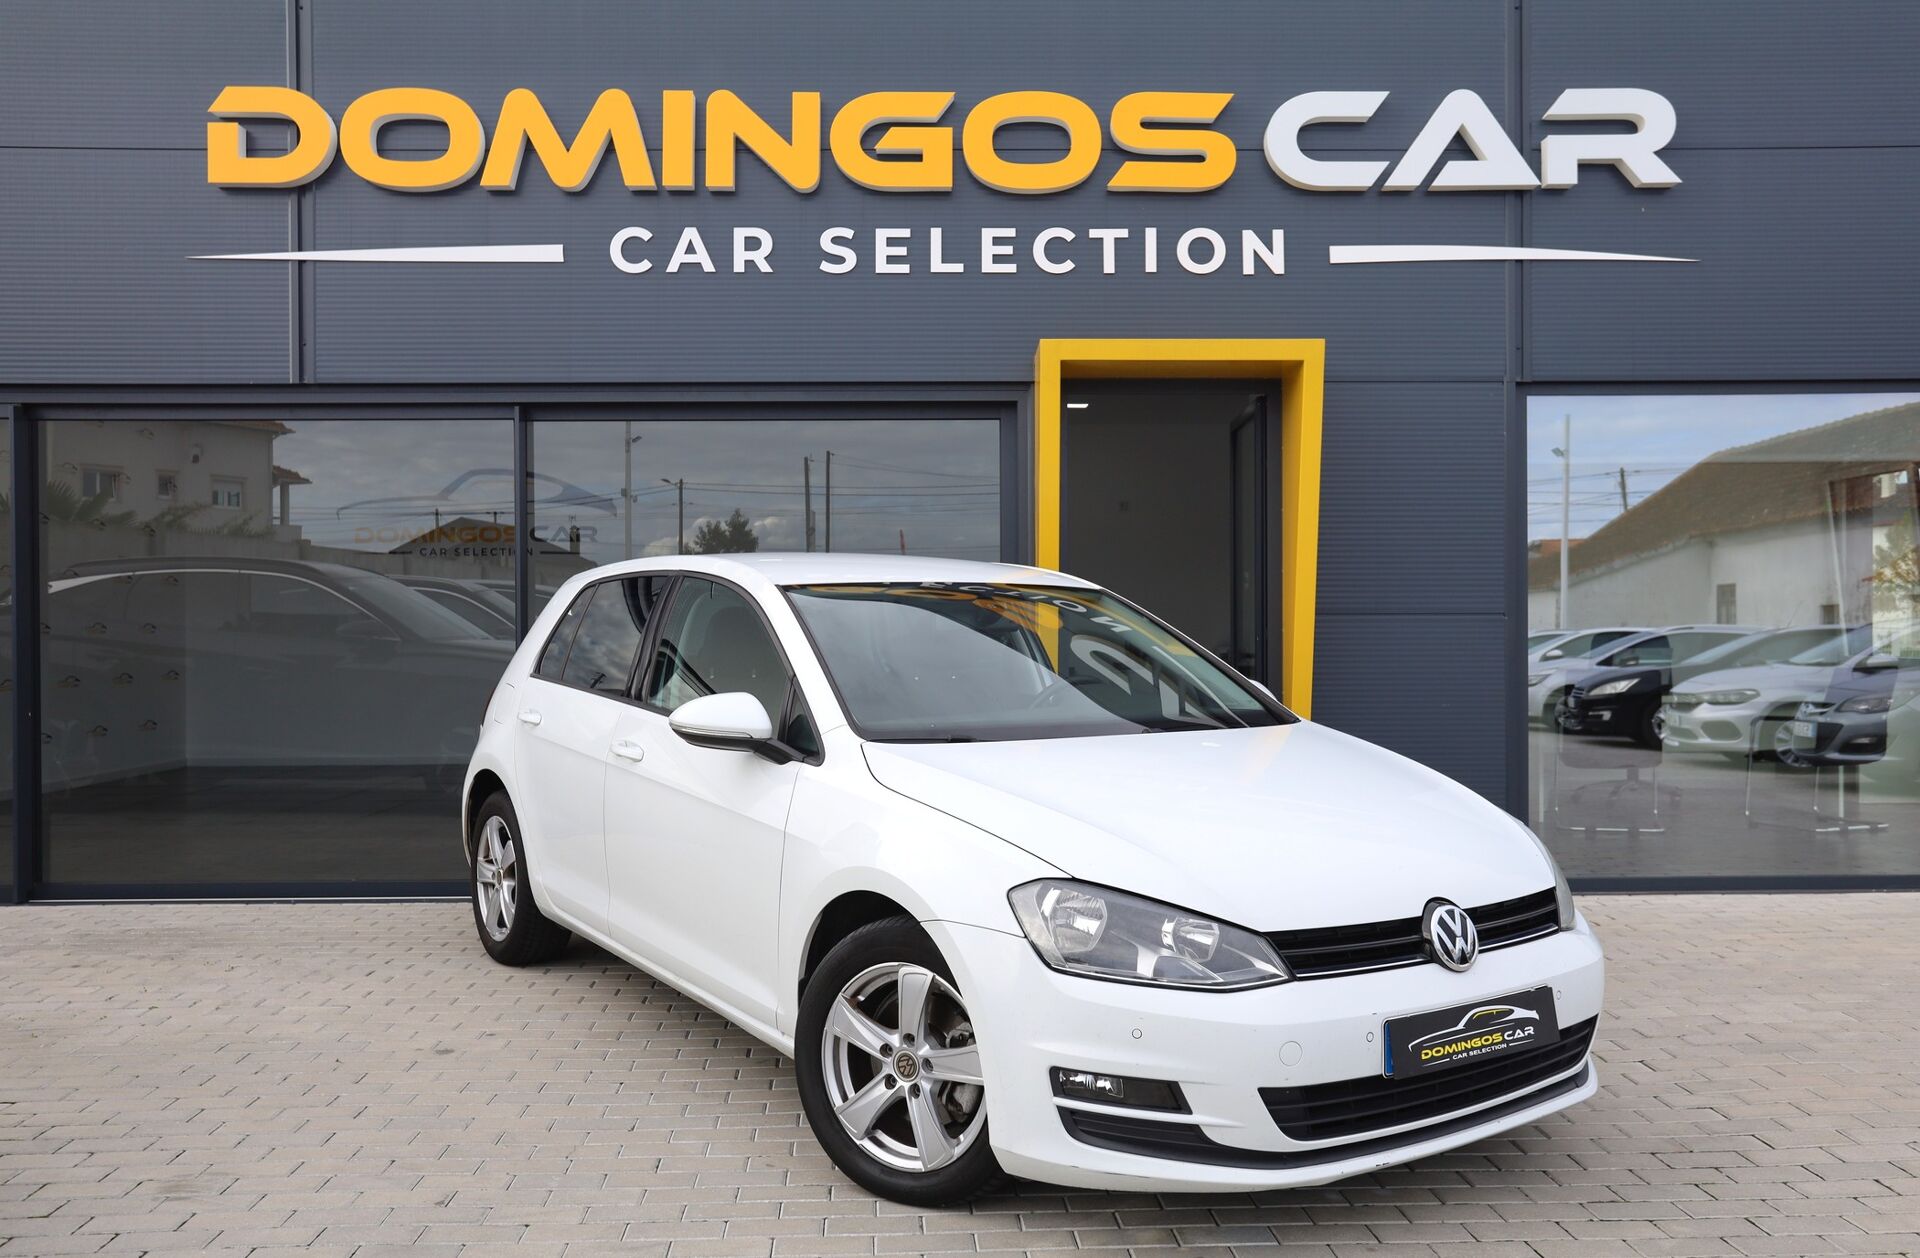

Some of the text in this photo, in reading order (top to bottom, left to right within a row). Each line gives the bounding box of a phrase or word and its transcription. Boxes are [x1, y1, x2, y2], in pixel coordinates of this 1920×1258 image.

[207, 86, 1683, 193] DOMINGOS CAR
[609, 226, 1286, 275] CAR SELECTION
[353, 526, 598, 544] DOMINGOS CAR
[419, 547, 534, 557] CAR SELECTIN
[1421, 1026, 1535, 1060] DOMINGOS CAR
[1469, 1043, 1507, 1056] SELECTION
